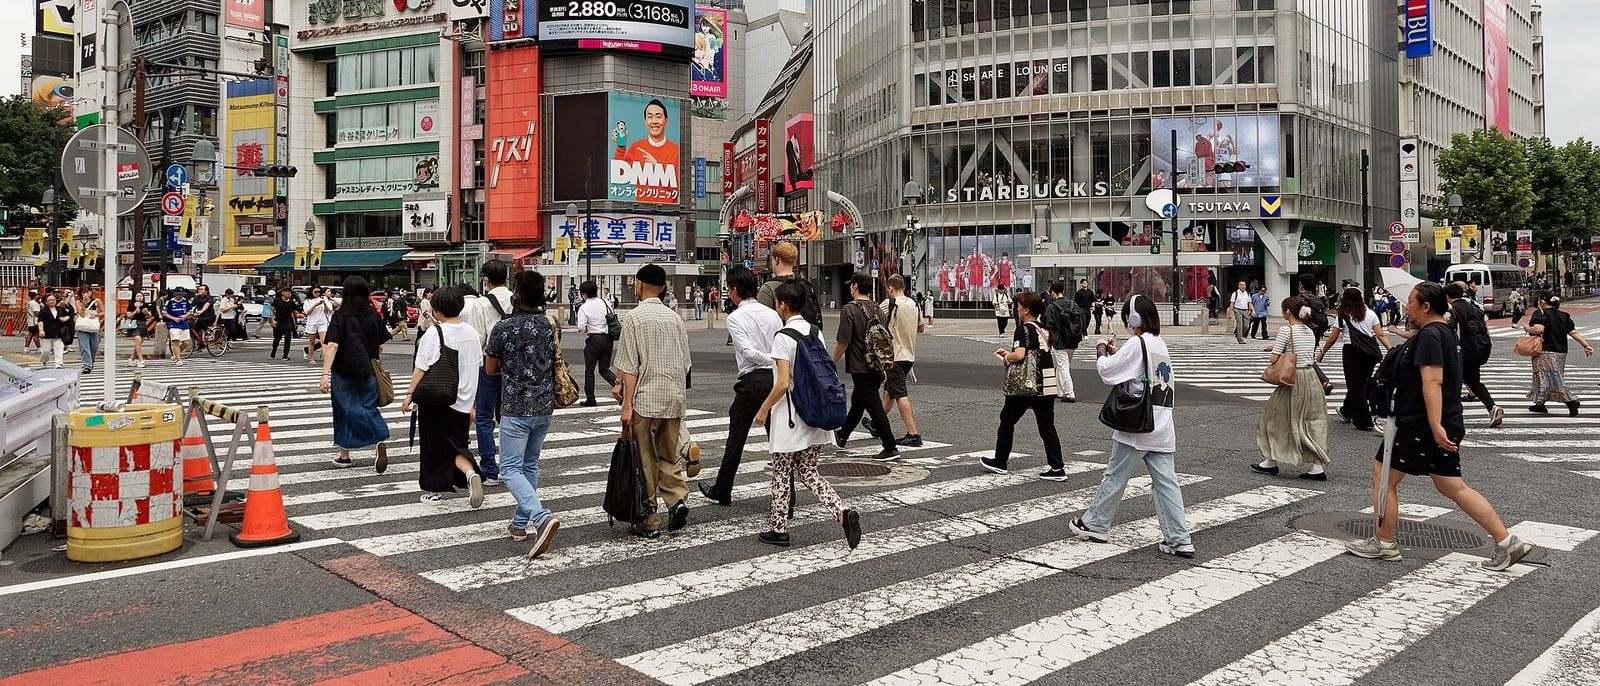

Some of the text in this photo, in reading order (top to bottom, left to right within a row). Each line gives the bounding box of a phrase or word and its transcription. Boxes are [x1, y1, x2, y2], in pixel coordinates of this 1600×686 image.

[569, 1, 616, 17] 2,880
[83, 43, 94, 58] 7F
[963, 63, 1068, 82] SHARE LOUNGE
[229, 102, 258, 111] Matsumoto
[758, 126, 767, 174] カラオケ
[611, 159, 677, 187] DMM
[610, 186, 678, 199] オンラインクリニック
[947, 181, 1107, 201] STARBUCKS
[1188, 202, 1251, 212] TSUTAYA
[558, 220, 672, 242] 大盛堂書店
